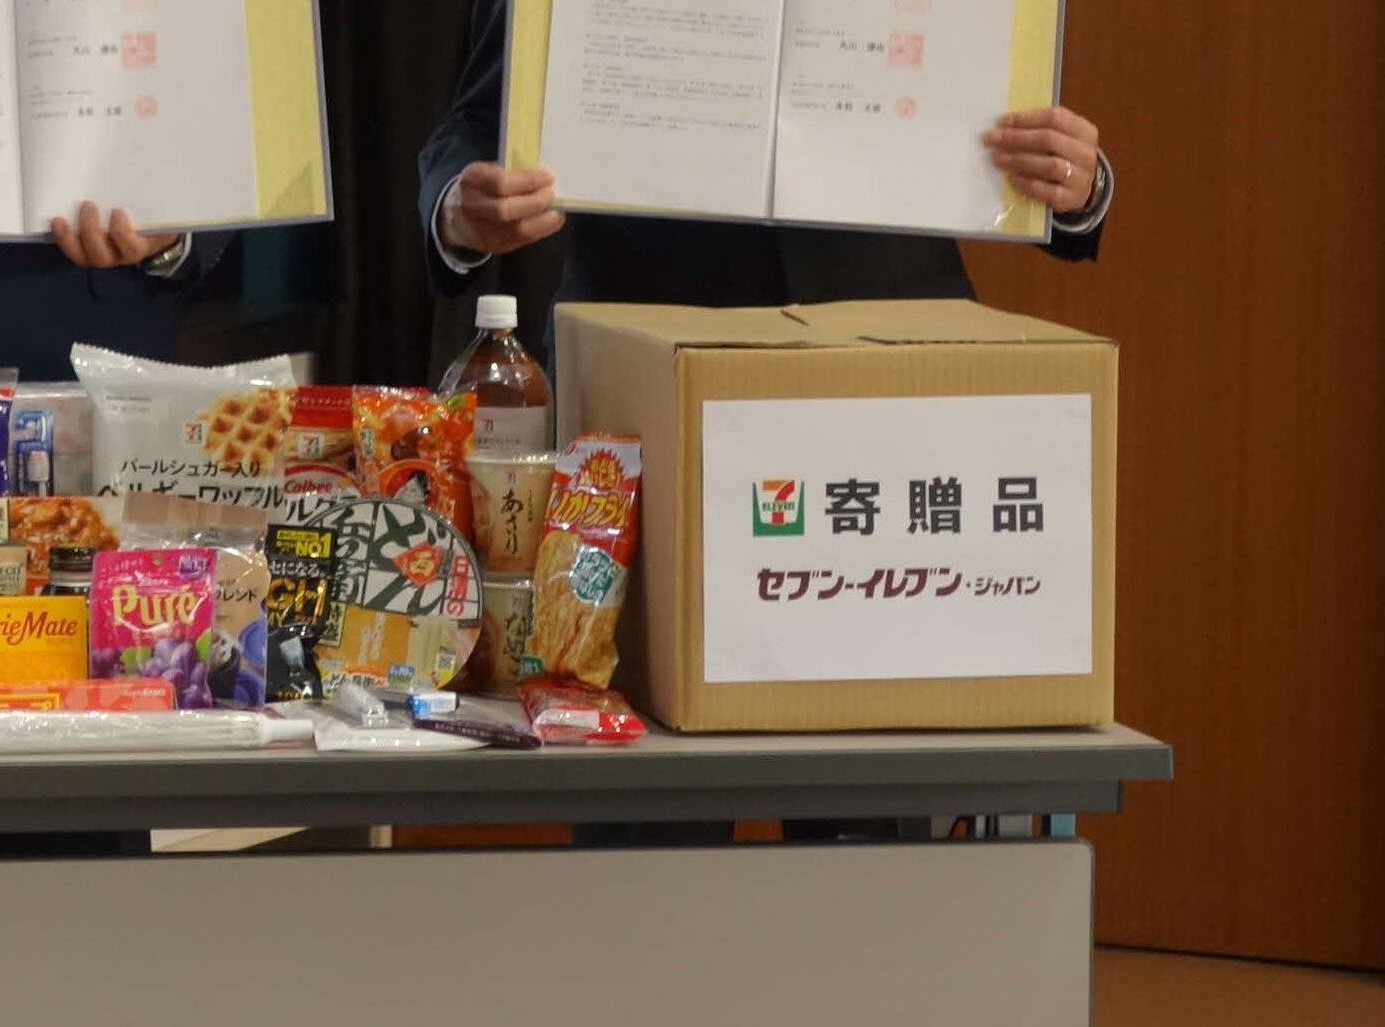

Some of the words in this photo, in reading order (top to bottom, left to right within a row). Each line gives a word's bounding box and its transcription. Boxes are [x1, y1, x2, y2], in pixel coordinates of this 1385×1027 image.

[120, 458, 261, 478] パールシュガー入り
[284, 479, 334, 495] Calbee
[824, 475, 1045, 536] 寄贈品
